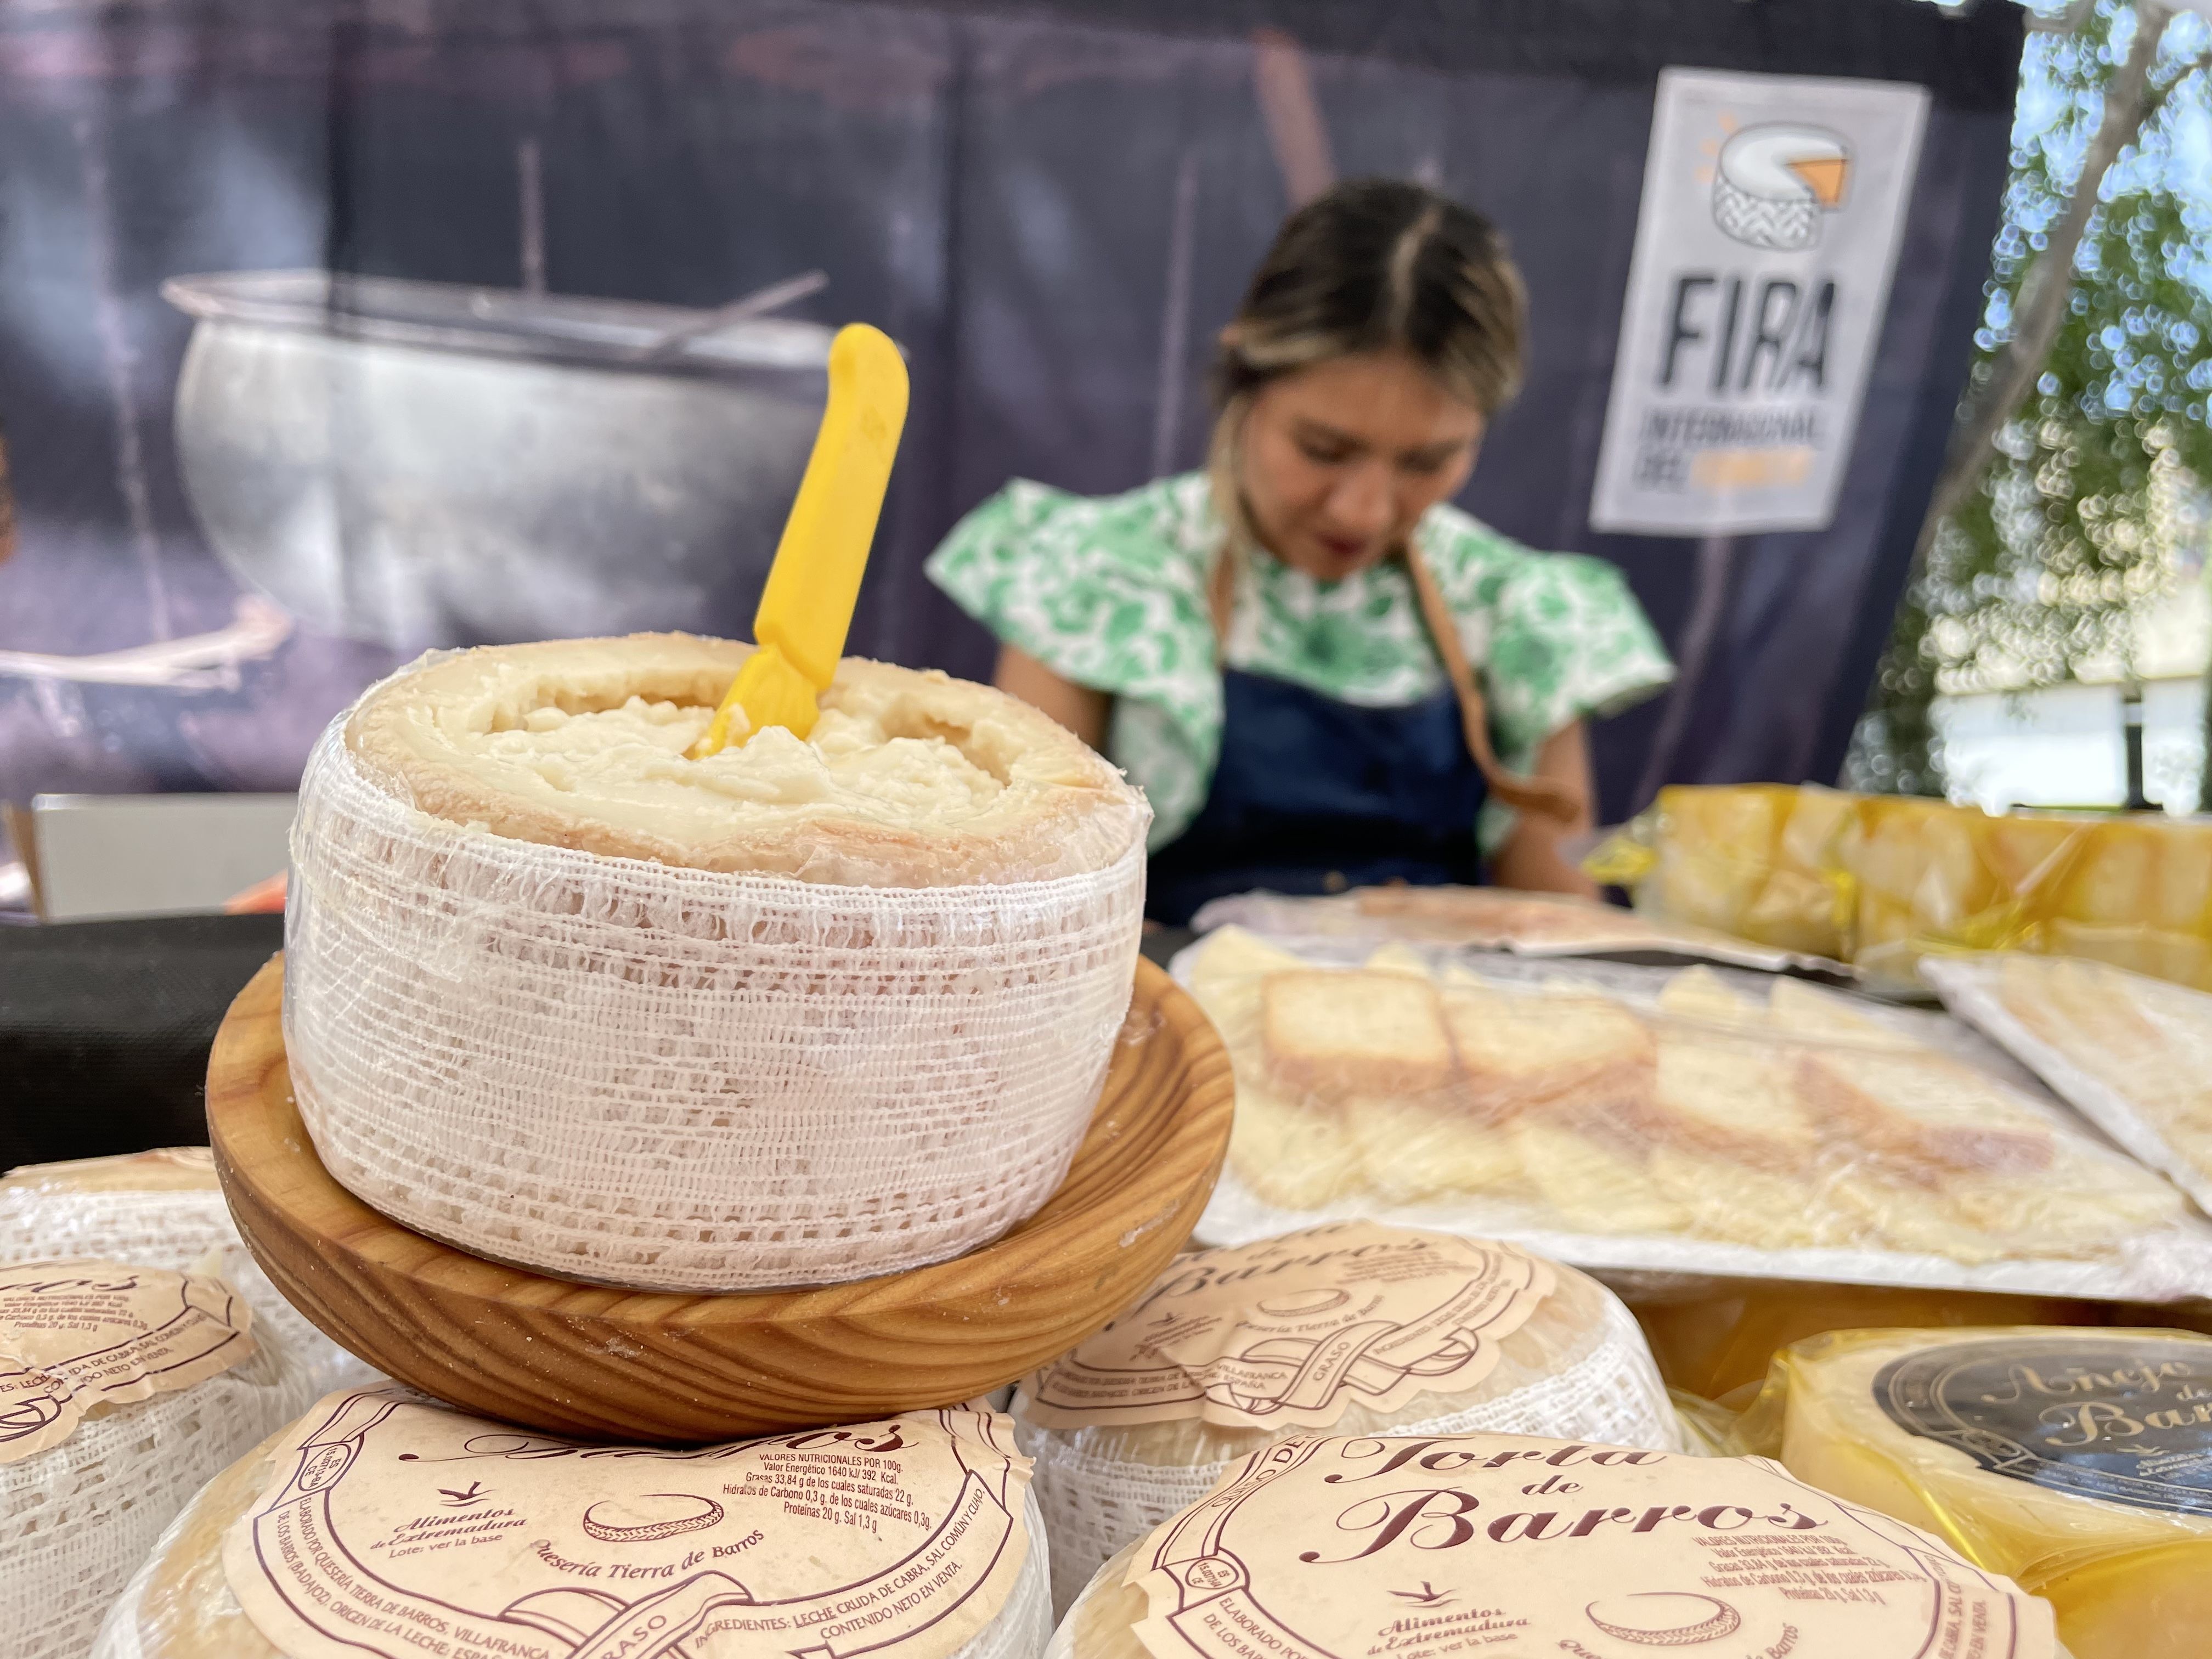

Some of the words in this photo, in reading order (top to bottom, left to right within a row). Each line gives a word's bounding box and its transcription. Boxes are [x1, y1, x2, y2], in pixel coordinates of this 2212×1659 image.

[1658, 270, 1837, 393] FIRA
[20, 1373, 52, 1389] LECH
[91, 1358, 106, 1367] DE
[103, 1364, 131, 1376] NETO
[1313, 1342, 1351, 1381] GRASO
[2038, 1401, 2212, 1447] Bar
[329, 1458, 342, 1469] ES
[799, 1454, 862, 1466] NUTRICIONALES
[864, 1458, 881, 1468] POR
[883, 1460, 903, 1472] 100g.
[1273, 1441, 1305, 1464] DE
[1324, 1436, 1667, 1484] Torta
[304, 1466, 317, 1476] CE
[764, 1462, 783, 1471] Valor
[786, 1464, 825, 1475] Energético
[828, 1466, 847, 1476] 1640
[862, 1470, 876, 1481] 392
[881, 1472, 899, 1485] Kcal.
[746, 1472, 772, 1483] Grasas
[775, 1474, 797, 1485] 33,84
[799, 1477, 804, 1488] g
[806, 1477, 815, 1487] de
[817, 1478, 828, 1488] los
[831, 1481, 855, 1492] cuales
[857, 1483, 893, 1499] saturadas
[895, 1488, 905, 1502] 22
[907, 1493, 913, 1506] g.
[1521, 1475, 1583, 1496] de
[723, 1484, 756, 1496] Hidratos
[759, 1486, 768, 1496] de
[771, 1487, 803, 1500] Carbono
[805, 1492, 817, 1502] 0,3
[830, 1493, 839, 1504] de
[841, 1494, 852, 1507] los
[855, 1497, 878, 1513] cuales
[880, 1504, 912, 1522] azúcares
[914, 1511, 932, 1531] 0,3g.
[964, 1510, 974, 1521] Y
[967, 1488, 986, 1516] CUAJO.
[278, 1510, 290, 1523] DE
[278, 1523, 290, 1537] LOS
[300, 1497, 317, 1540] ELABORADO
[393, 1509, 516, 1532] Alimentos
[784, 1502, 820, 1519] Proteínas
[822, 1508, 832, 1520] 20
[834, 1511, 842, 1524] g.
[844, 1511, 856, 1526] Sal
[858, 1514, 870, 1530] 1,3
[872, 1519, 877, 1533] g
[1299, 1486, 1829, 1565] Barros
[308, 1538, 323, 1555] POR
[370, 1541, 386, 1549] de
[388, 1519, 527, 1545] Extremadura
[389, 1545, 424, 1559] Lote:
[429, 1541, 452, 1551] ver
[455, 1538, 466, 1547] la
[471, 1534, 504, 1544] base
[941, 1521, 969, 1551] COMÚN
[1692, 1536, 1737, 1546] VALORES
[279, 1535, 299, 1563] BARROS
[531, 1539, 602, 1577] Quesería
[607, 1564, 675, 1578] Tierra
[681, 1550, 704, 1570] de
[712, 1530, 764, 1558] Barros
[926, 1549, 945, 1566] SAL
[314, 1551, 353, 1590] QUESERÍA
[893, 1565, 930, 1590] CABRA,
[349, 1584, 383, 1609] TIERRA
[820, 1607, 893, 1639] CONTENIDO
[891, 1593, 921, 1612] NETO
[921, 1582, 936, 1598] EN
[932, 1562, 963, 1586] VENTA.
[836, 1591, 879, 1613] CRUDA
[878, 1583, 892, 1598] DE
[330, 1601, 372, 1628] ORIGEN
[381, 1602, 400, 1615] DE
[793, 1609, 837, 1629] LECHE
[367, 1618, 386, 1630] DE
[382, 1621, 403, 1635] LA
[695, 1617, 792, 1648] INGREDIENTES:
[1203, 1613, 1221, 1630] DE
[1216, 1627, 1242, 1647] LOS
[1219, 1597, 1282, 1649] ELABORADO
[1378, 1609, 1506, 1636] Alimentos
[454, 1627, 549, 1659] VILLAFRANCA
[601, 1615, 667, 1659] RASO
[1367, 1645, 1383, 1655] de
[1385, 1618, 1531, 1650] Extremadura
[1439, 1641, 1462, 1652] ver
[1465, 1637, 1481, 1646] la
[1482, 1633, 1518, 1643] base
